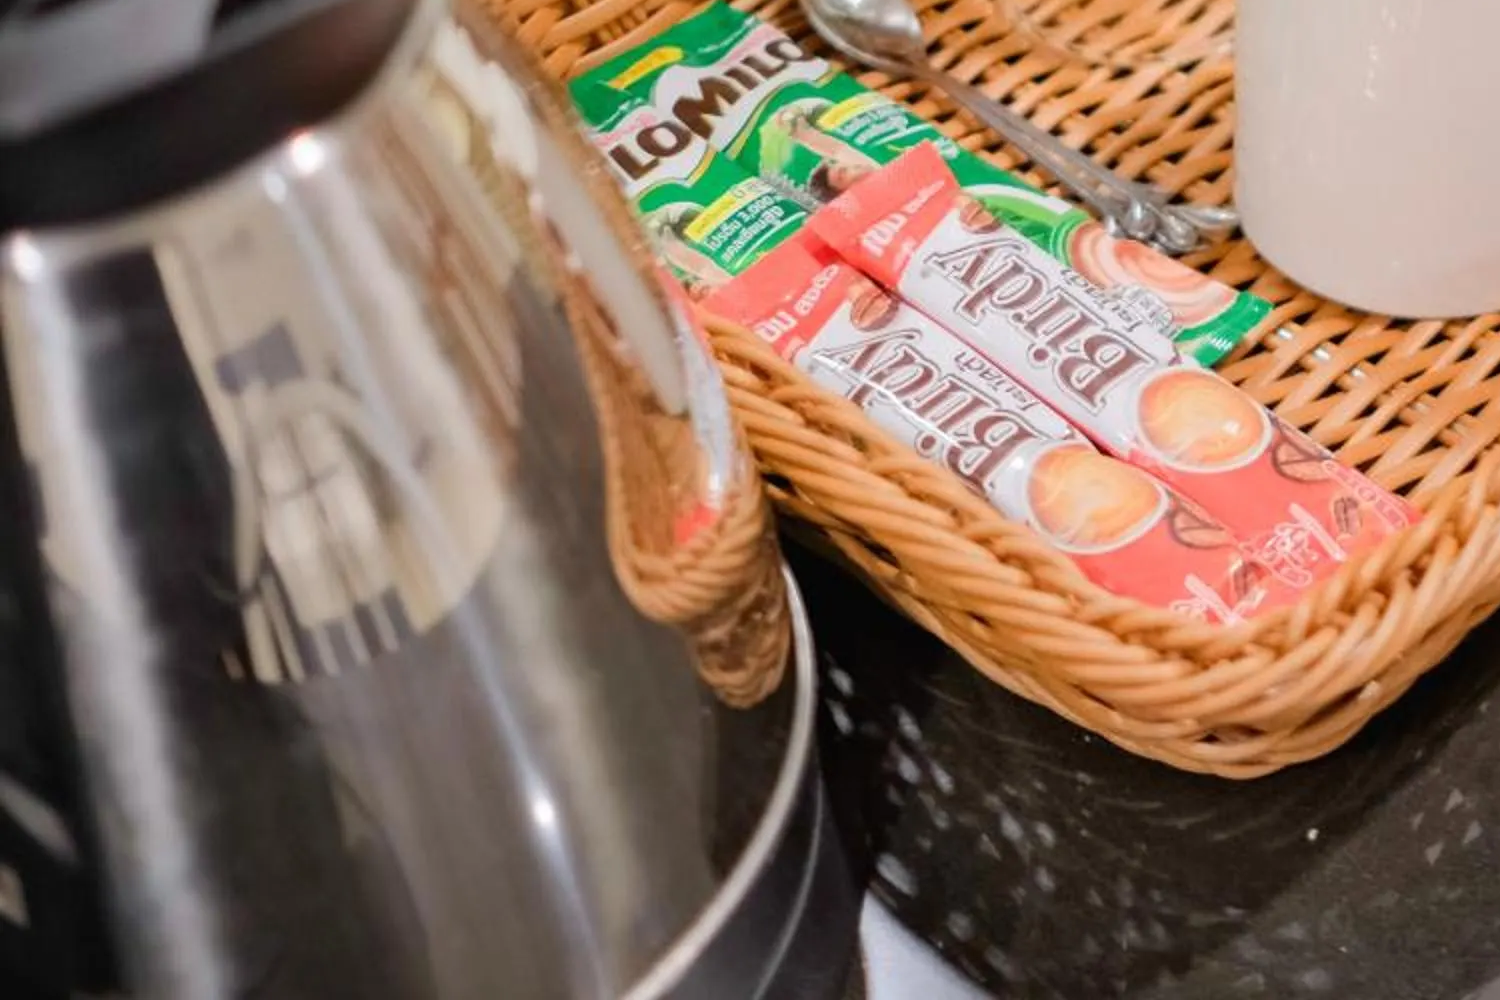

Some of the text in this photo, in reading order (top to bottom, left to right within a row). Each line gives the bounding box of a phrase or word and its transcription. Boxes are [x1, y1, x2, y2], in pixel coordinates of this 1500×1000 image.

[608, 121, 693, 182] LO
[672, 38, 816, 141] MILO
[923, 238, 1158, 414] Birdy
[813, 328, 1040, 500] Birdy
